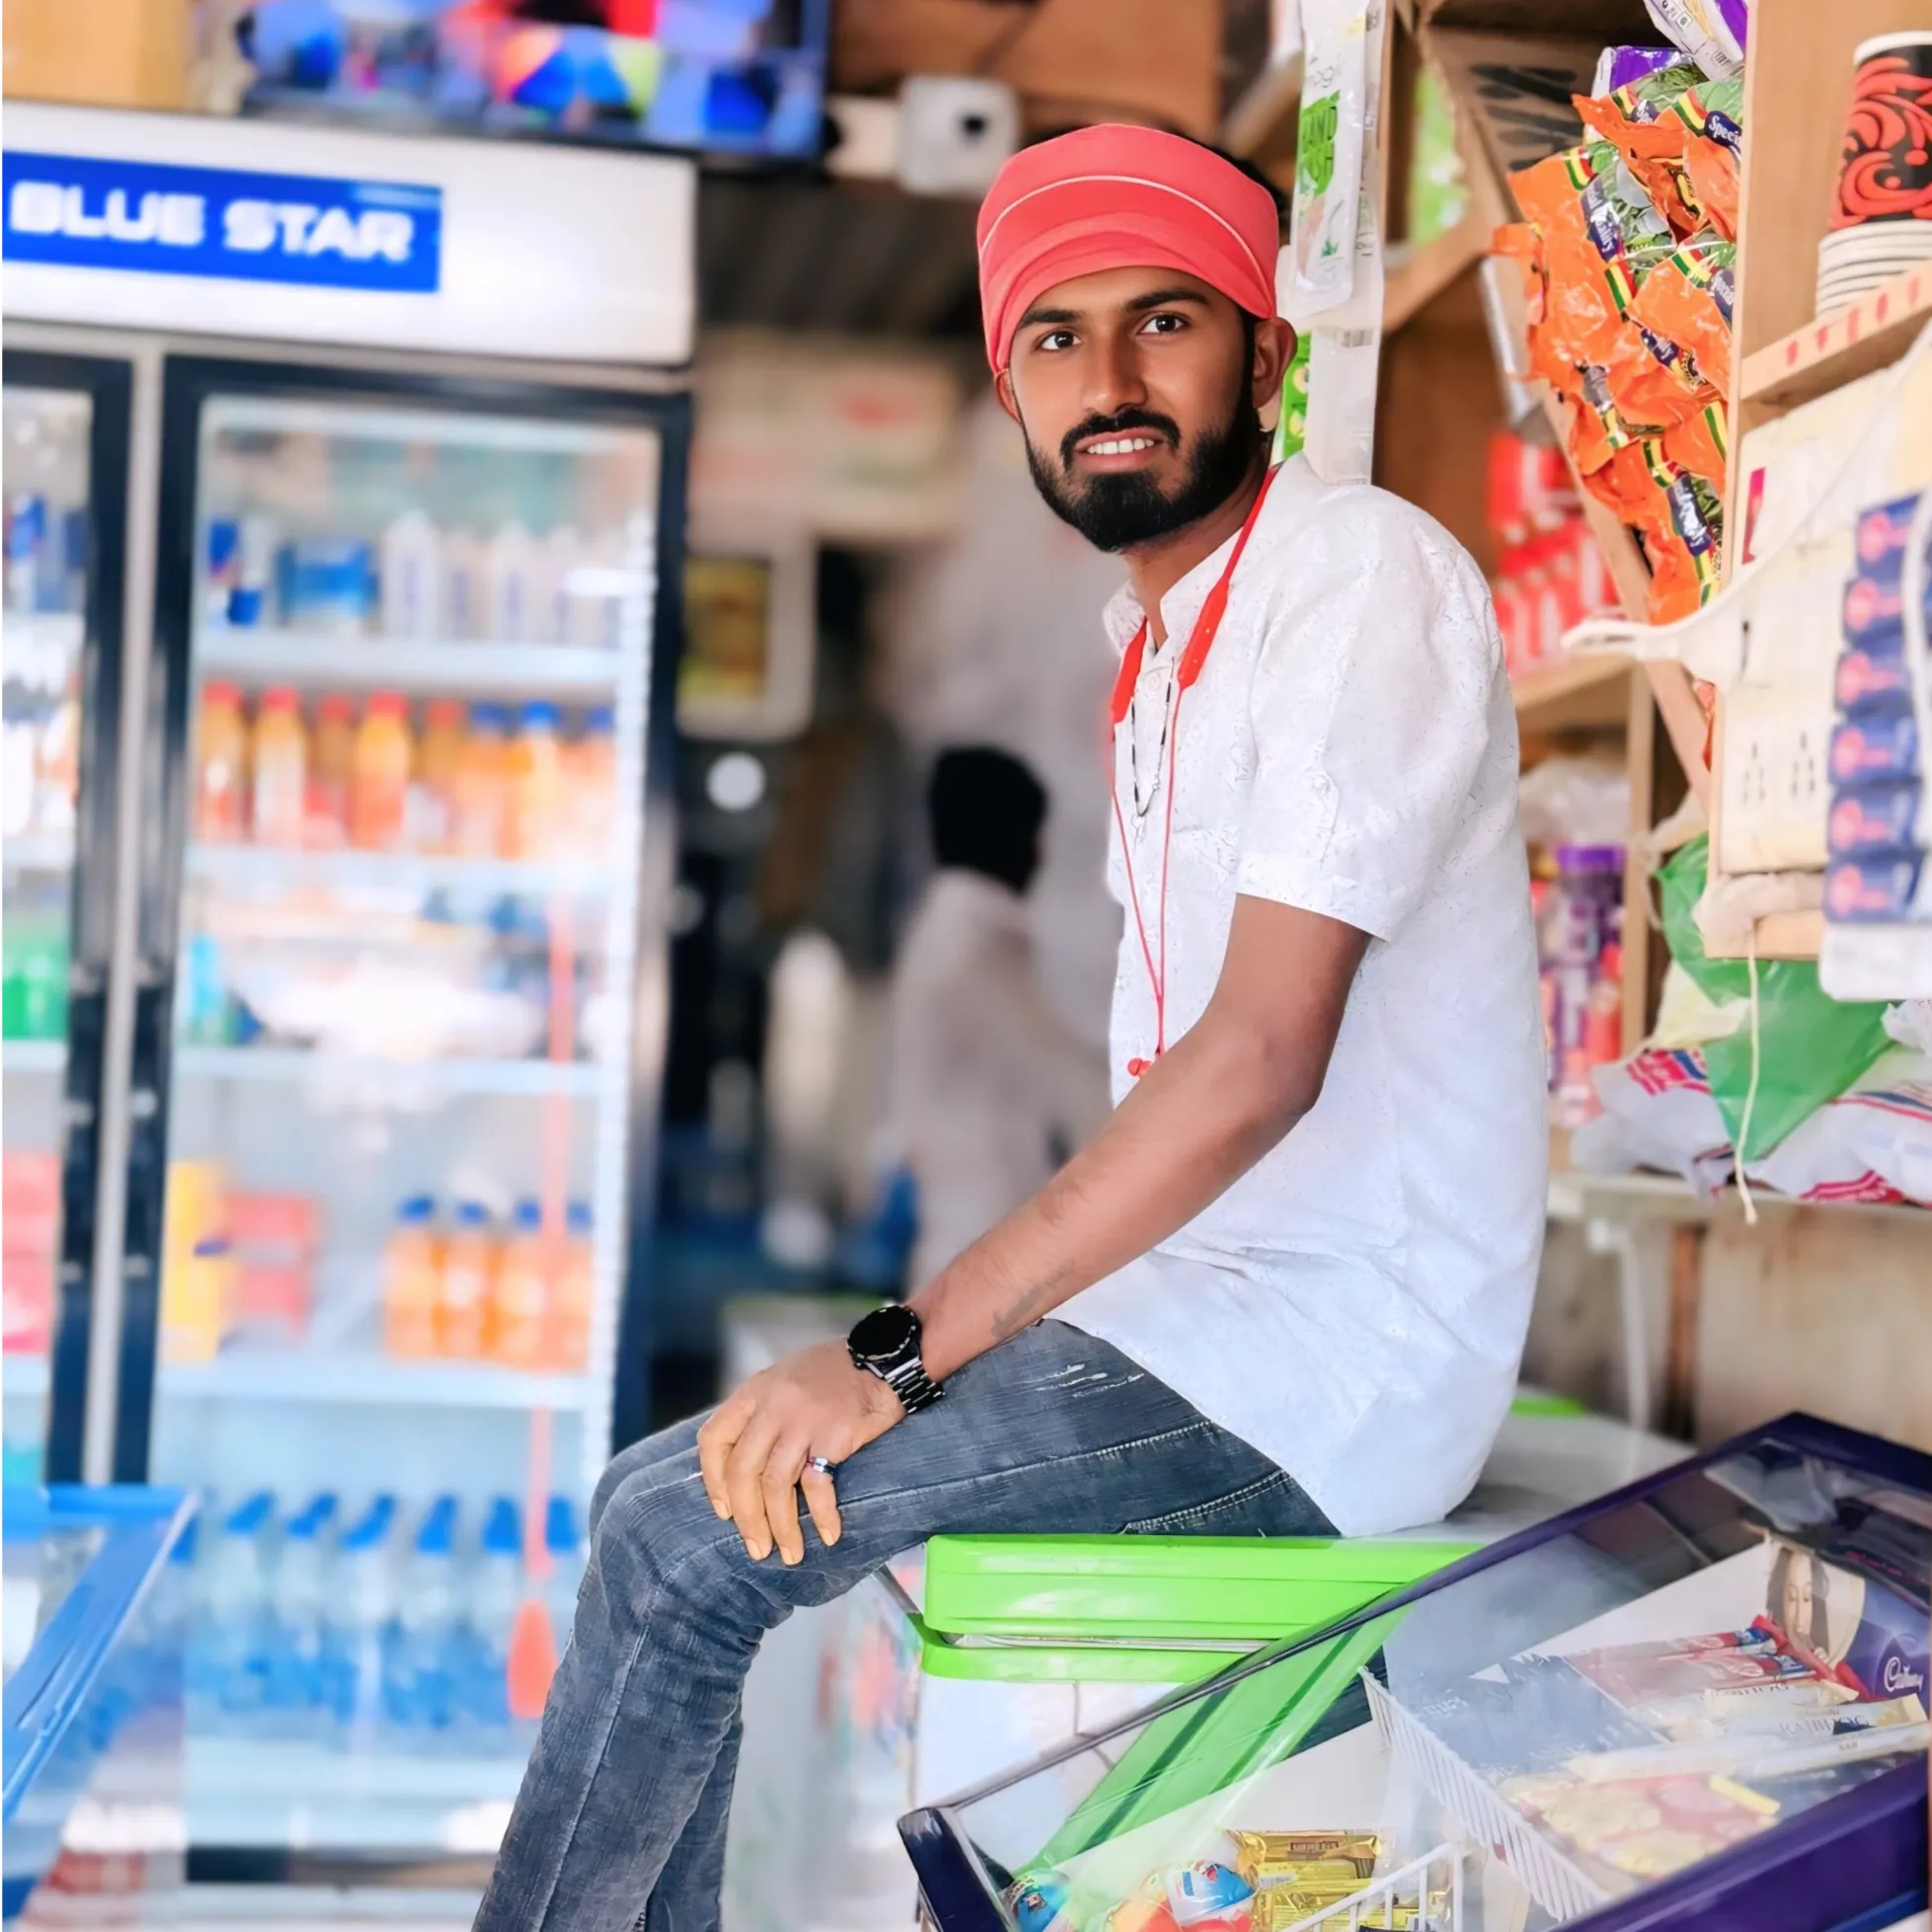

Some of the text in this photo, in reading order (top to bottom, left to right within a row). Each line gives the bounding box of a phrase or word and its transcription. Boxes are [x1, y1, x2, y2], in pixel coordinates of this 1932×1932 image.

[1708, 115, 1740, 146] Speci
[10, 181, 414, 262] BLUE STAR
